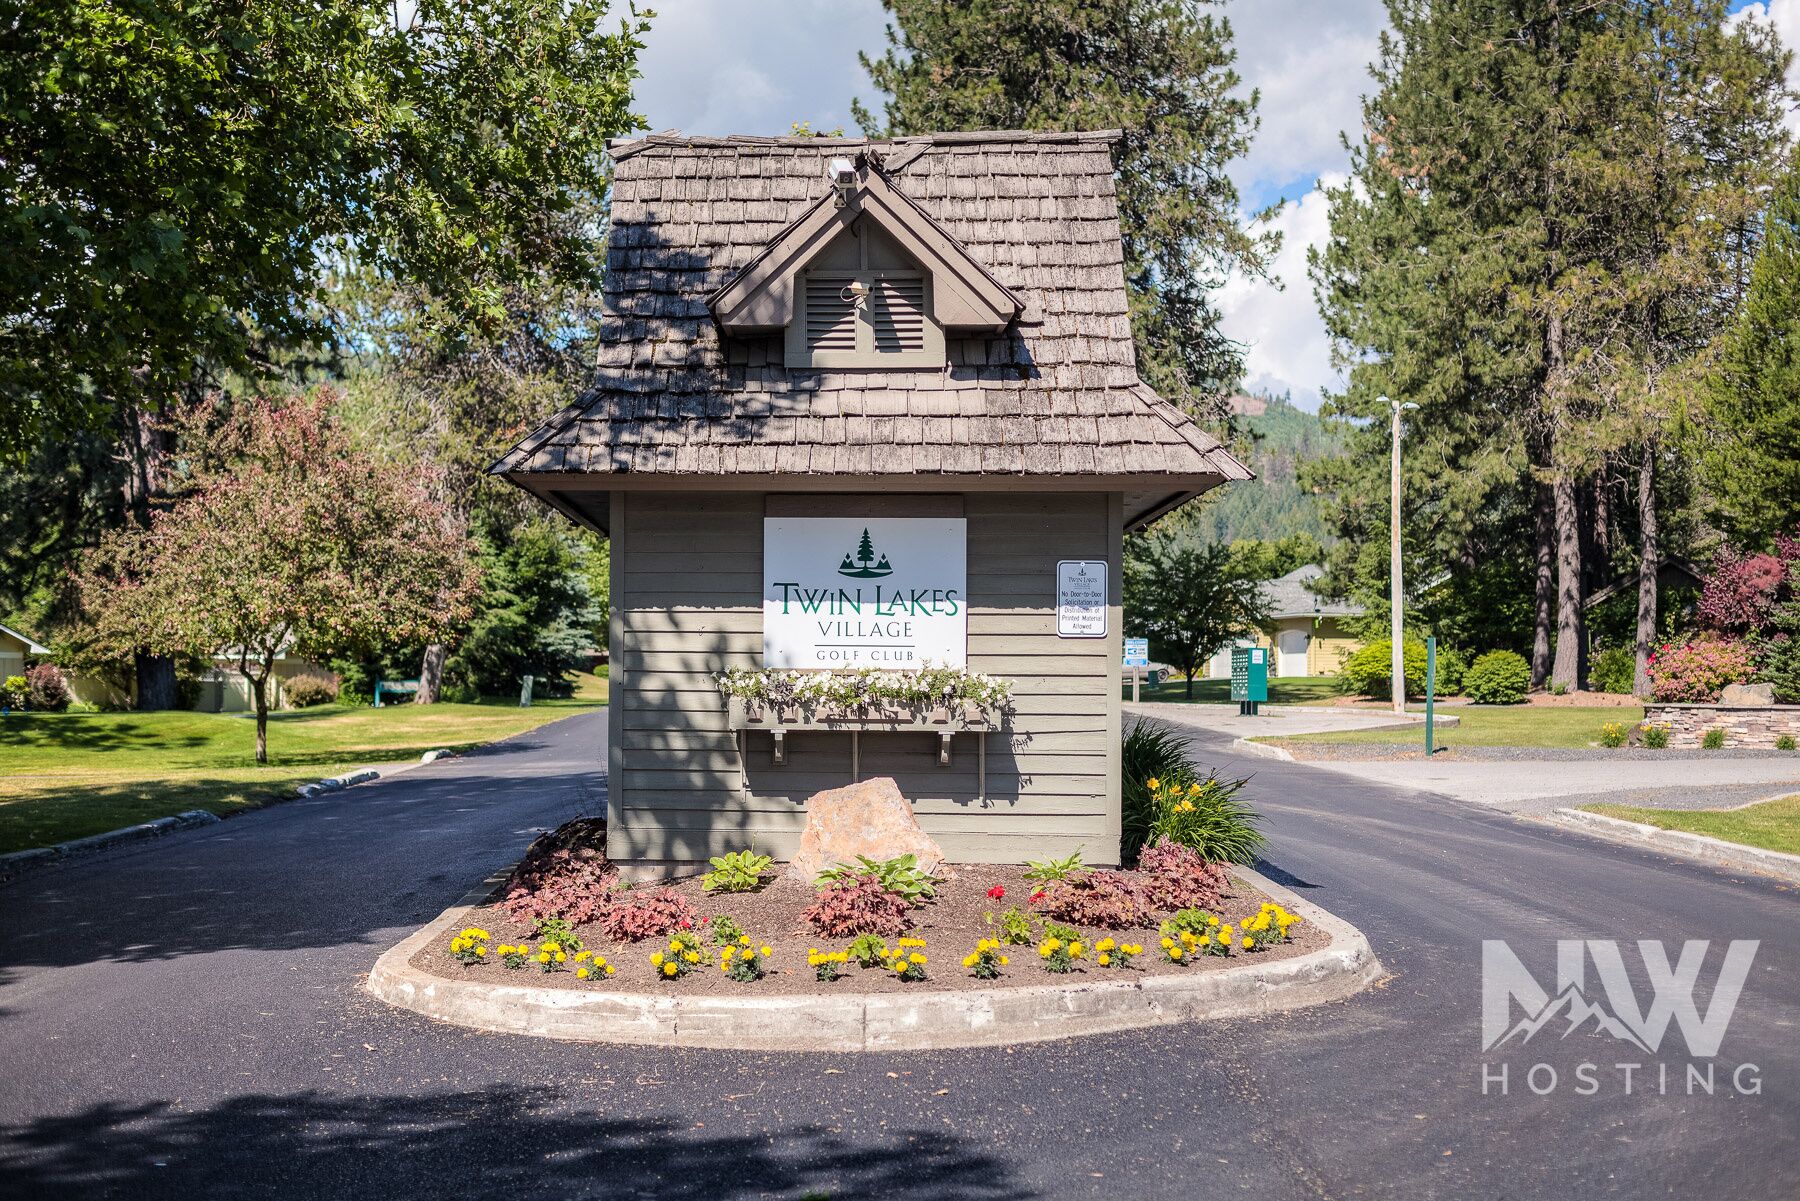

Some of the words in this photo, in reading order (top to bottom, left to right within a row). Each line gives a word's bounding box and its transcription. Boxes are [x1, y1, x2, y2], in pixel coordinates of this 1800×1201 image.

[773, 583, 861, 615] TWIN
[875, 585, 959, 617] LAKES
[818, 622, 913, 637] VILLAGE
[816, 650, 859, 660] GOLF
[871, 651, 913, 661] CLUB
